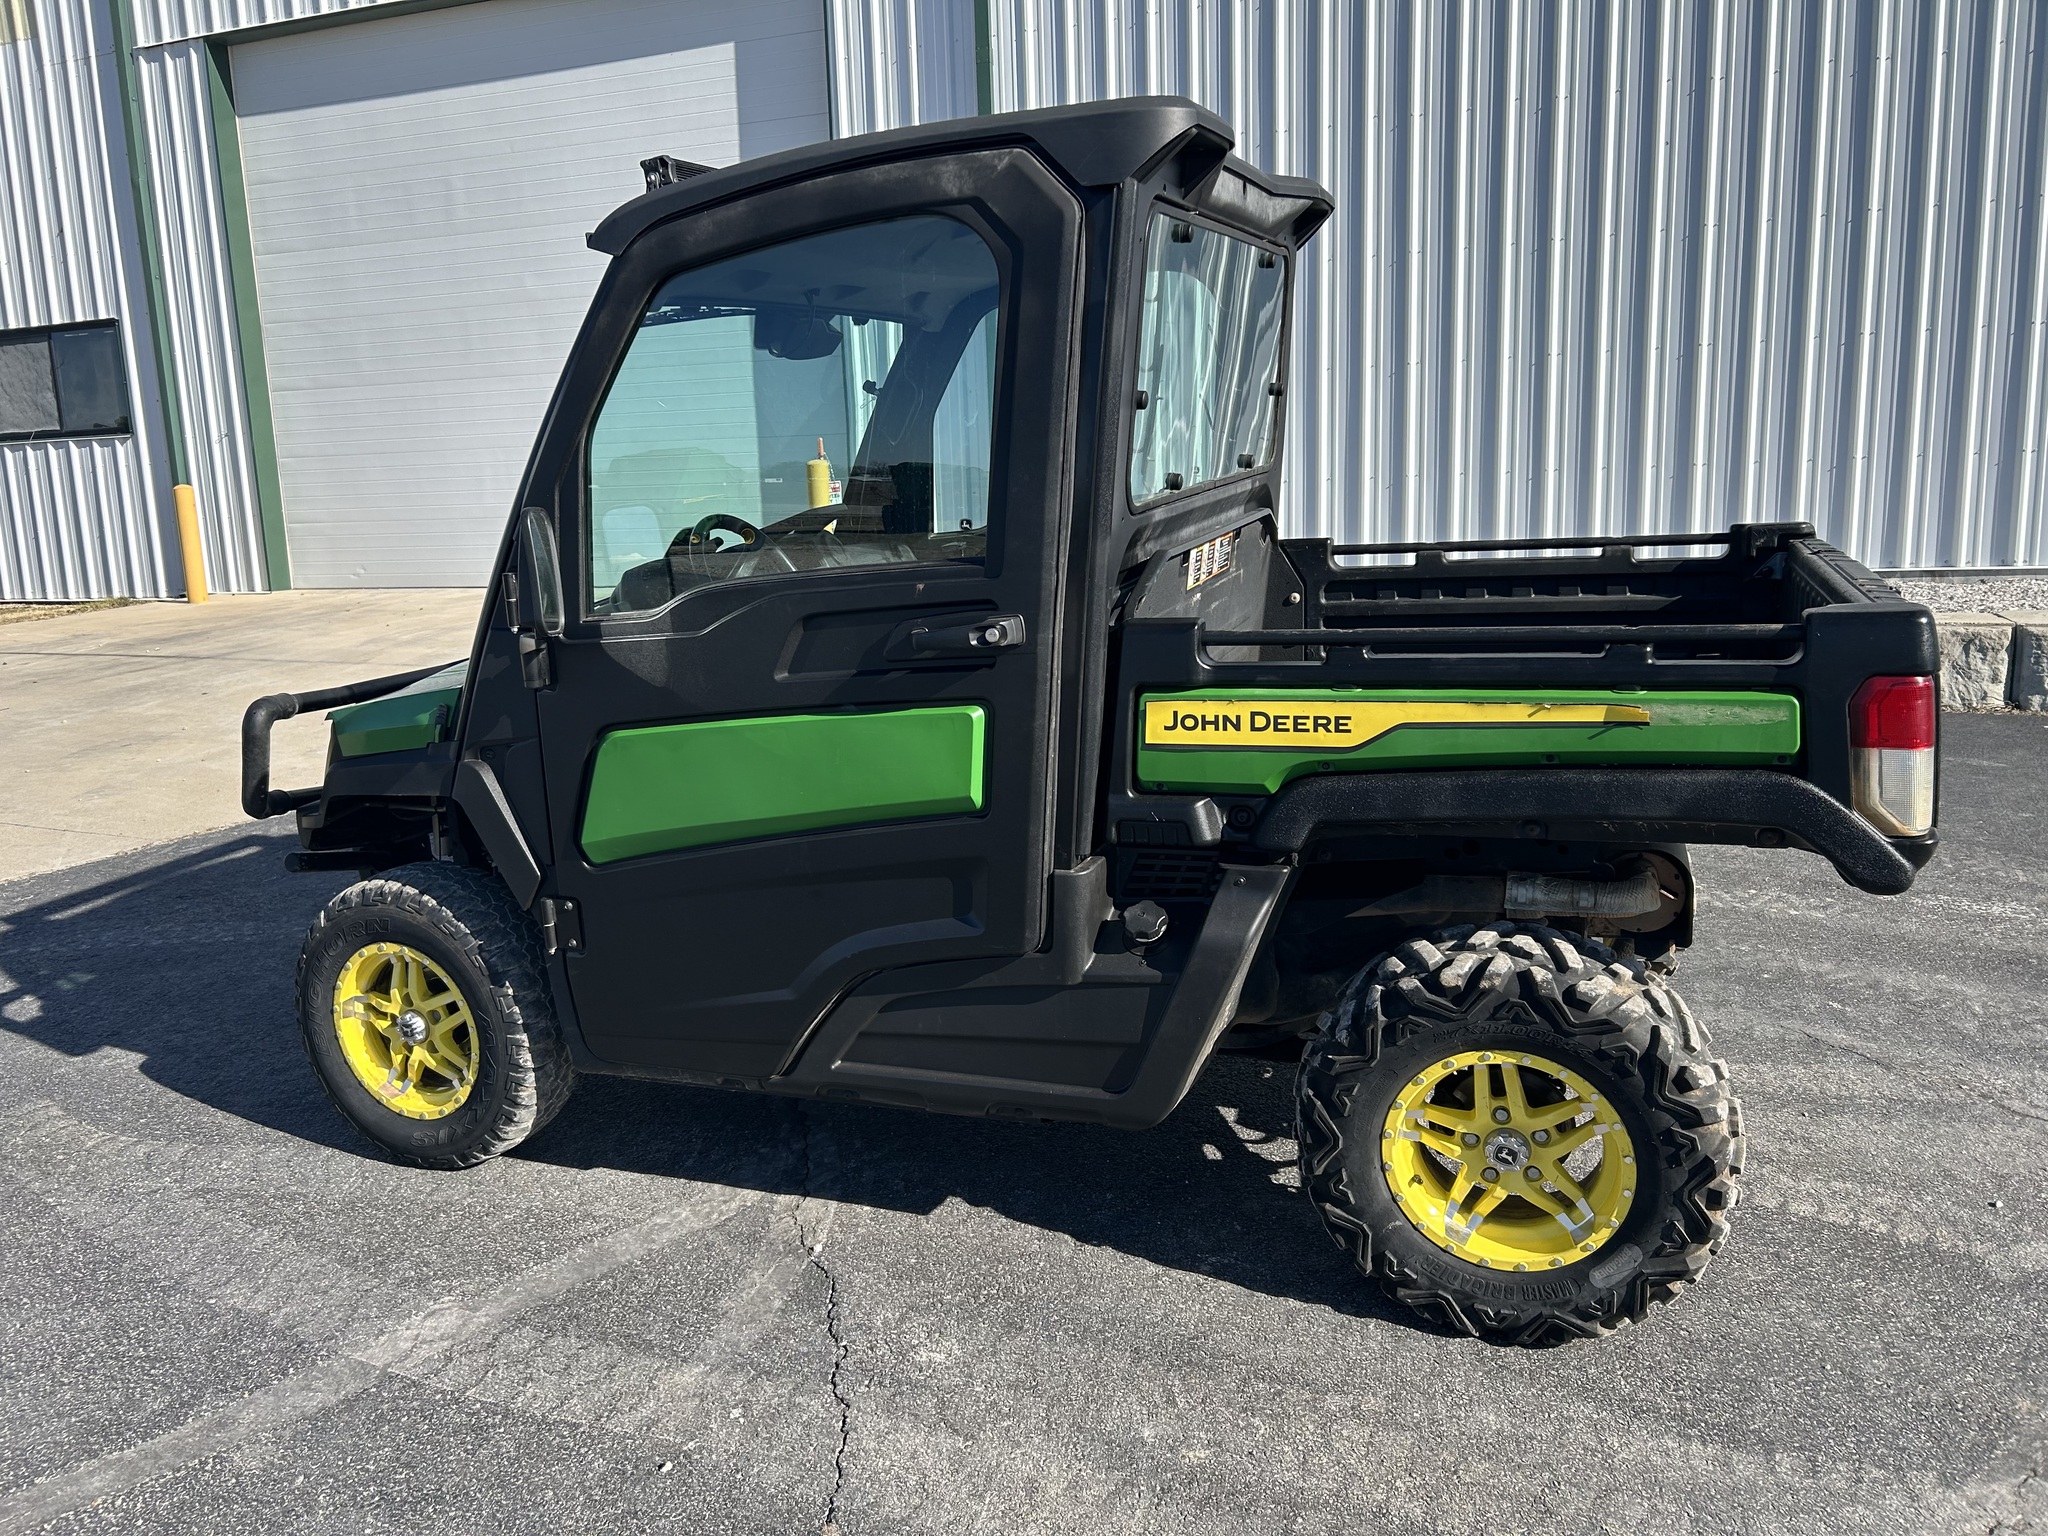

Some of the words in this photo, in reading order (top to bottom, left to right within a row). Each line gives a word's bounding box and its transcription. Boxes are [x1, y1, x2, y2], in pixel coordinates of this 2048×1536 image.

[1164, 710, 1241, 732] JOHN
[1250, 711, 1352, 734] DEERE
[308, 917, 391, 1058] BIGHORN
[410, 1009, 498, 1147] MAXXIS
[1418, 1254, 1517, 1301] BRIGADIER
[1592, 1246, 1632, 1280] BRIGADIER
[1521, 1278, 1576, 1301] MASTER
